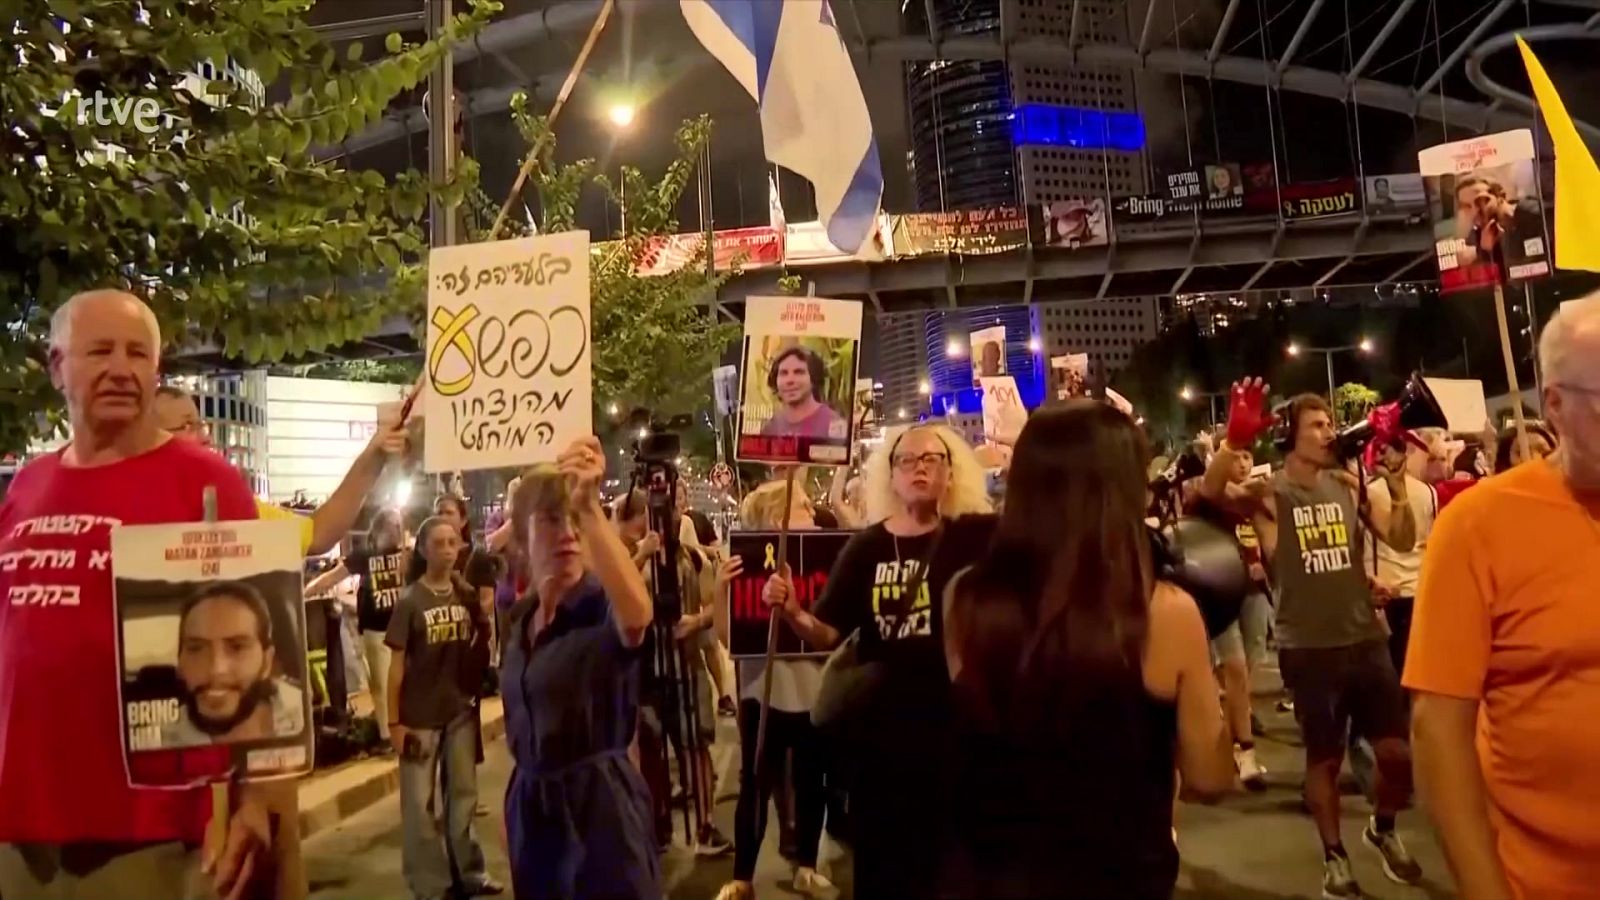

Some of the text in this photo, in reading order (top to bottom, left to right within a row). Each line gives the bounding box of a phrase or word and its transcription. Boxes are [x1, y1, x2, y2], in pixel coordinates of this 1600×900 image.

[1129, 196, 1164, 216] Bring
[1299, 191, 1355, 216] לעסקה
[475, 253, 572, 290] בלעדיהם
[451, 388, 573, 437] מהנצחון
[460, 420, 555, 452] המוחלט
[1293, 502, 1344, 528] למה הם
[1297, 523, 1348, 552] עדיין
[0, 548, 113, 571] א מחליפ
[1302, 546, 1352, 574] בעזה?
[371, 571, 401, 592] דיין
[875, 561, 899, 585] הם
[8, 583, 81, 608] בקלפי
[872, 580, 931, 614] עיין
[127, 698, 179, 725] BRING
